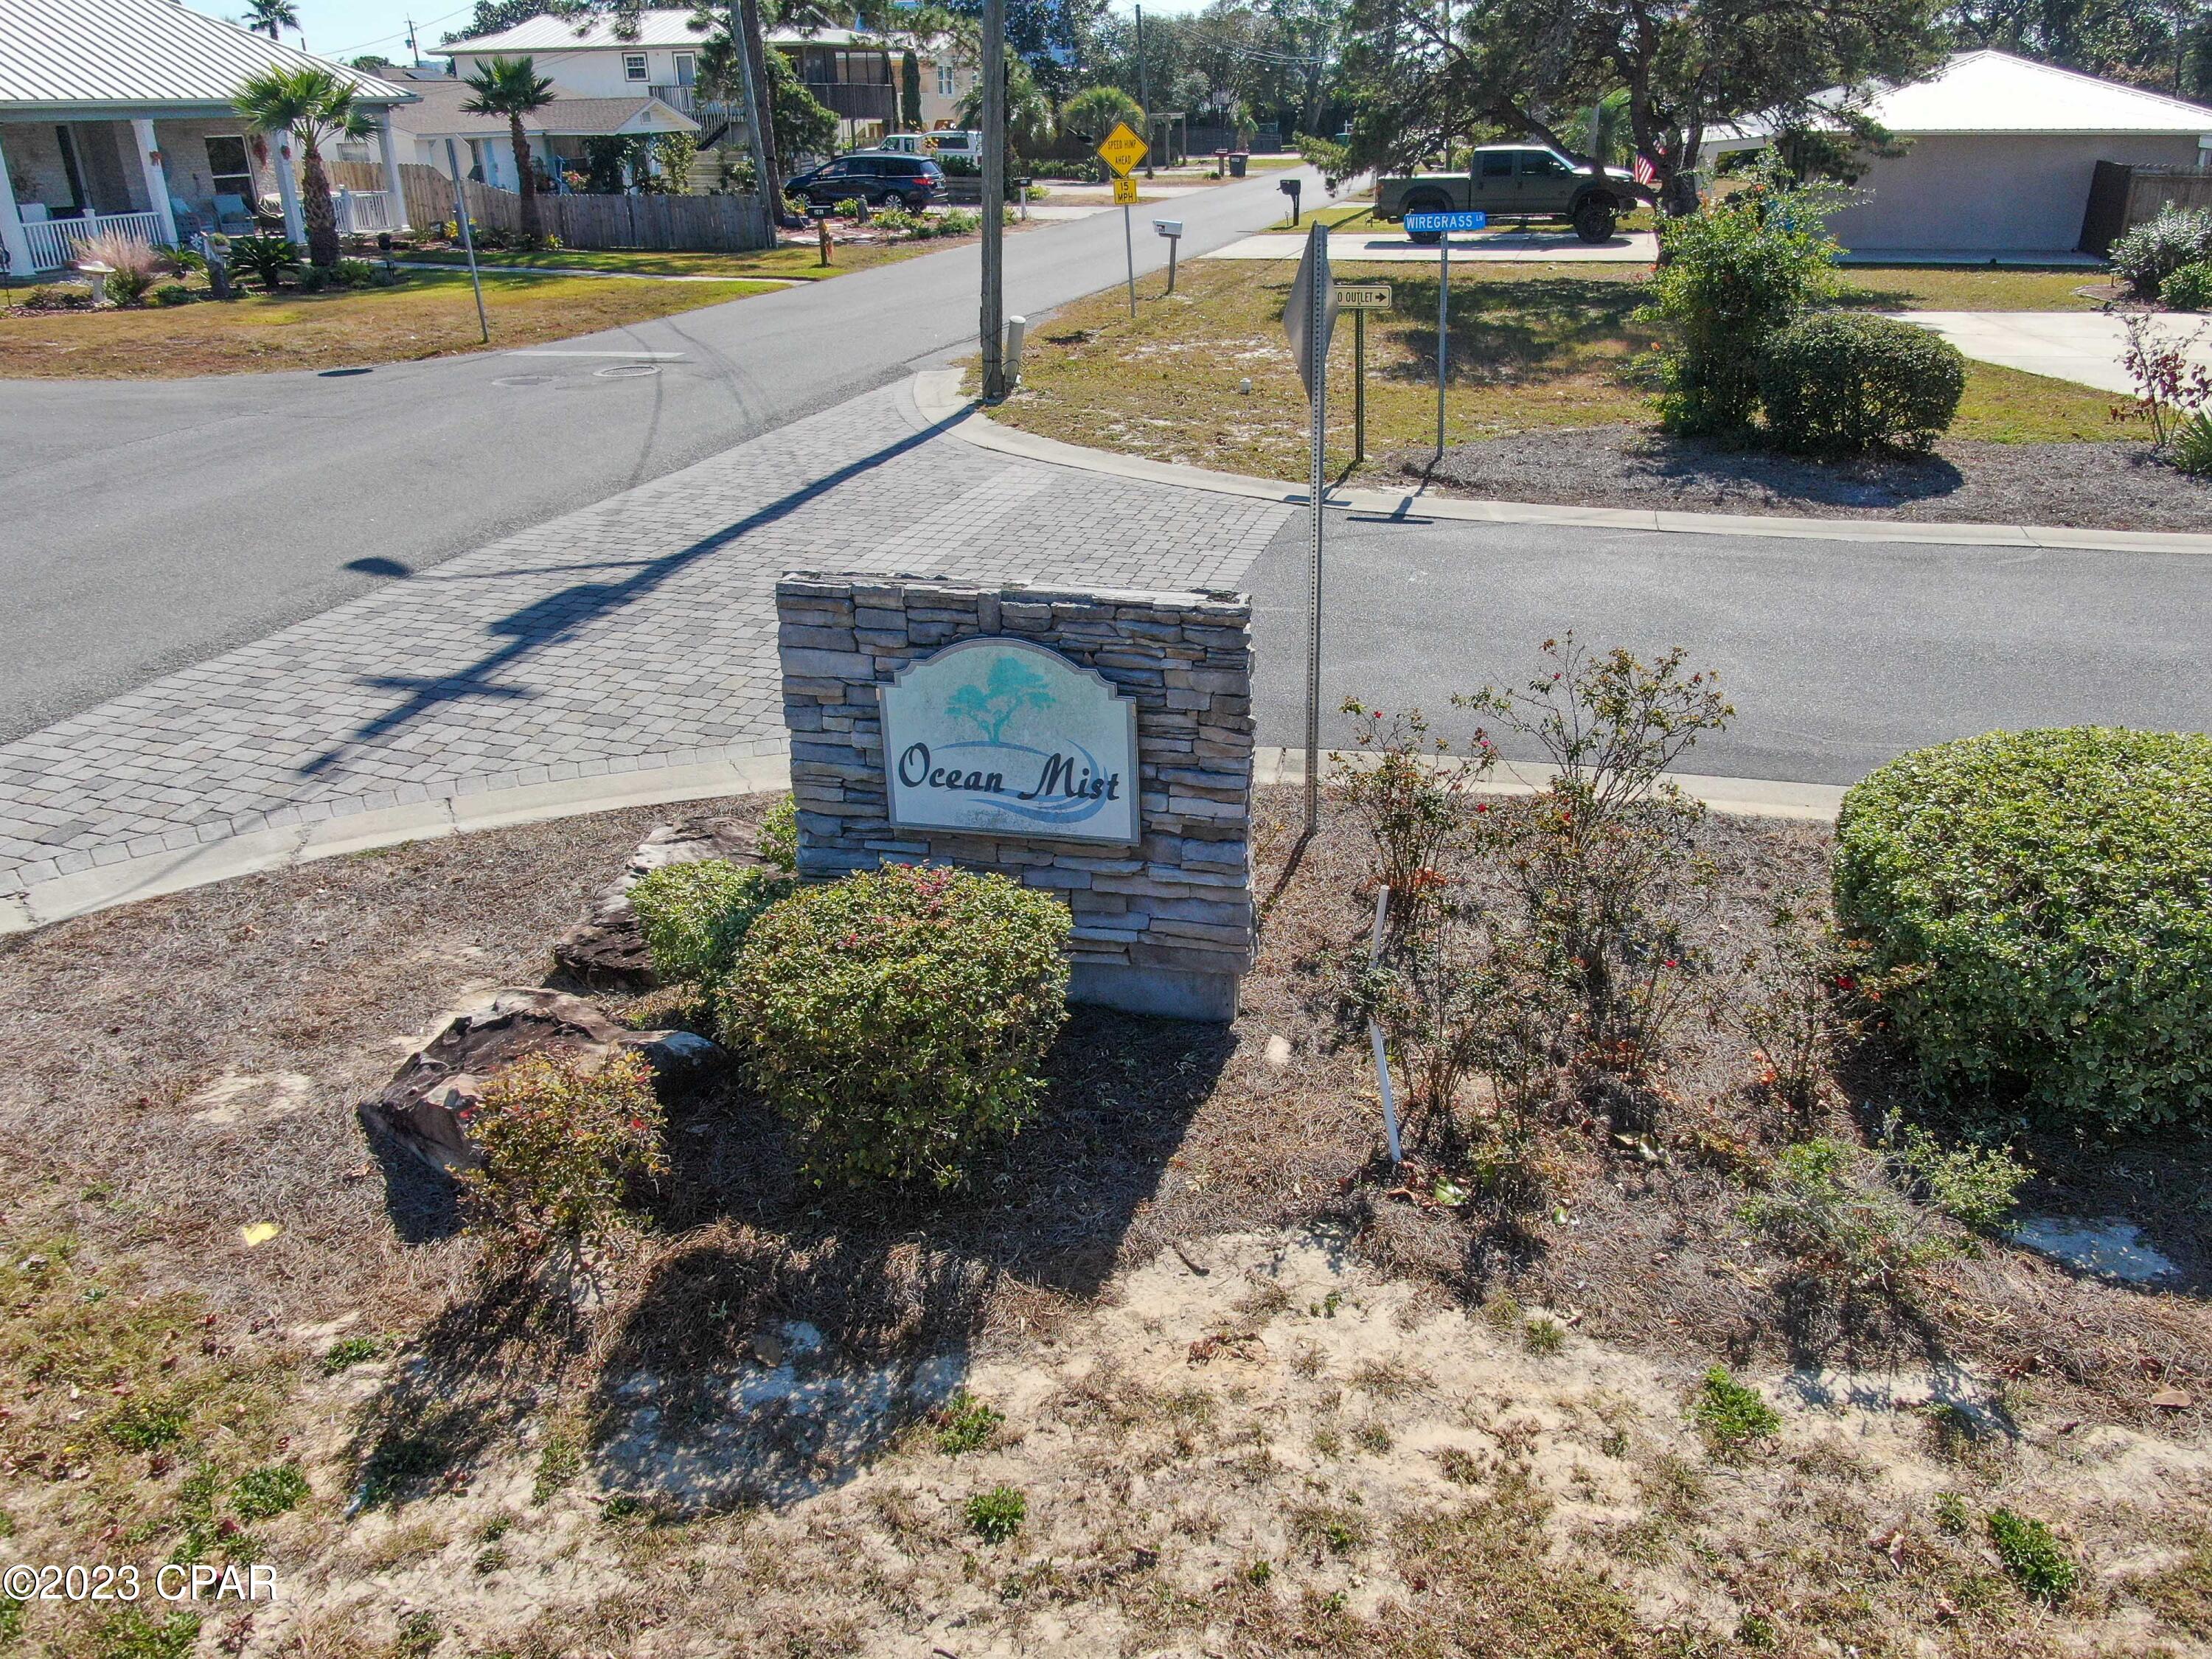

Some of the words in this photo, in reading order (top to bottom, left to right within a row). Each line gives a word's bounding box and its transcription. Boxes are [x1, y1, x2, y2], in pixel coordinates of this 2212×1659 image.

[1108, 140, 1122, 150] SPEED
[1124, 139, 1136, 148] HUMP
[1115, 156, 1131, 164] AHEAD
[1120, 181, 1129, 191] 15
[1118, 192, 1133, 202] MPH
[1406, 213, 1473, 229] WIREGRASS
[1346, 292, 1373, 302] OUTLET
[899, 742, 1004, 793] Ocean
[1018, 753, 1120, 801] Mist
